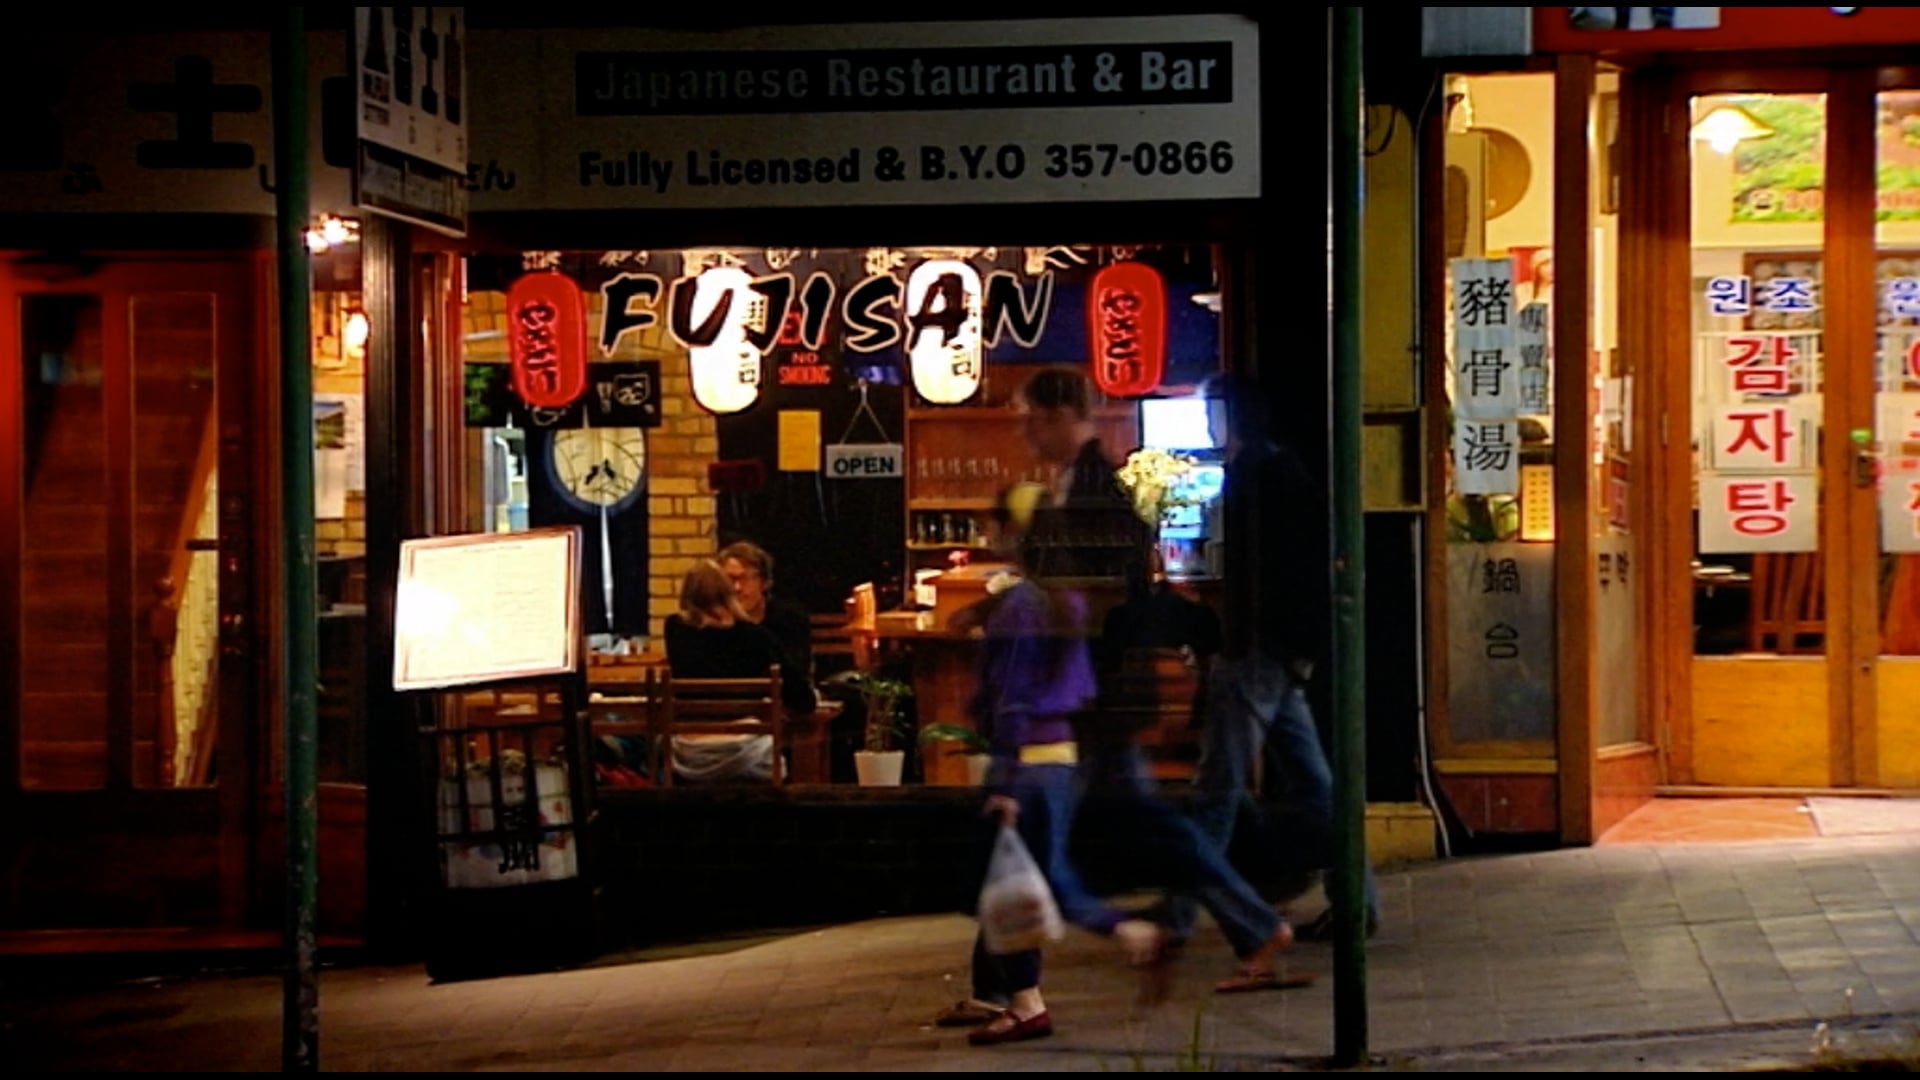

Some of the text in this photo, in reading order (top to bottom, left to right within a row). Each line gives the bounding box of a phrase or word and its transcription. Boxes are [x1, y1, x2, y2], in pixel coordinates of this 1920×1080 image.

[594, 49, 1218, 108] Japanese Restaurant & Bar
[579, 141, 1234, 193] Fully Licensed & B.Y.O 357-0866
[600, 269, 1053, 358] FUJISAN
[1707, 278, 1813, 315] 원조
[1459, 277, 1512, 472] 豬骨湯
[833, 456, 894, 474] OPEN
[1725, 336, 1795, 535] 감자탕
